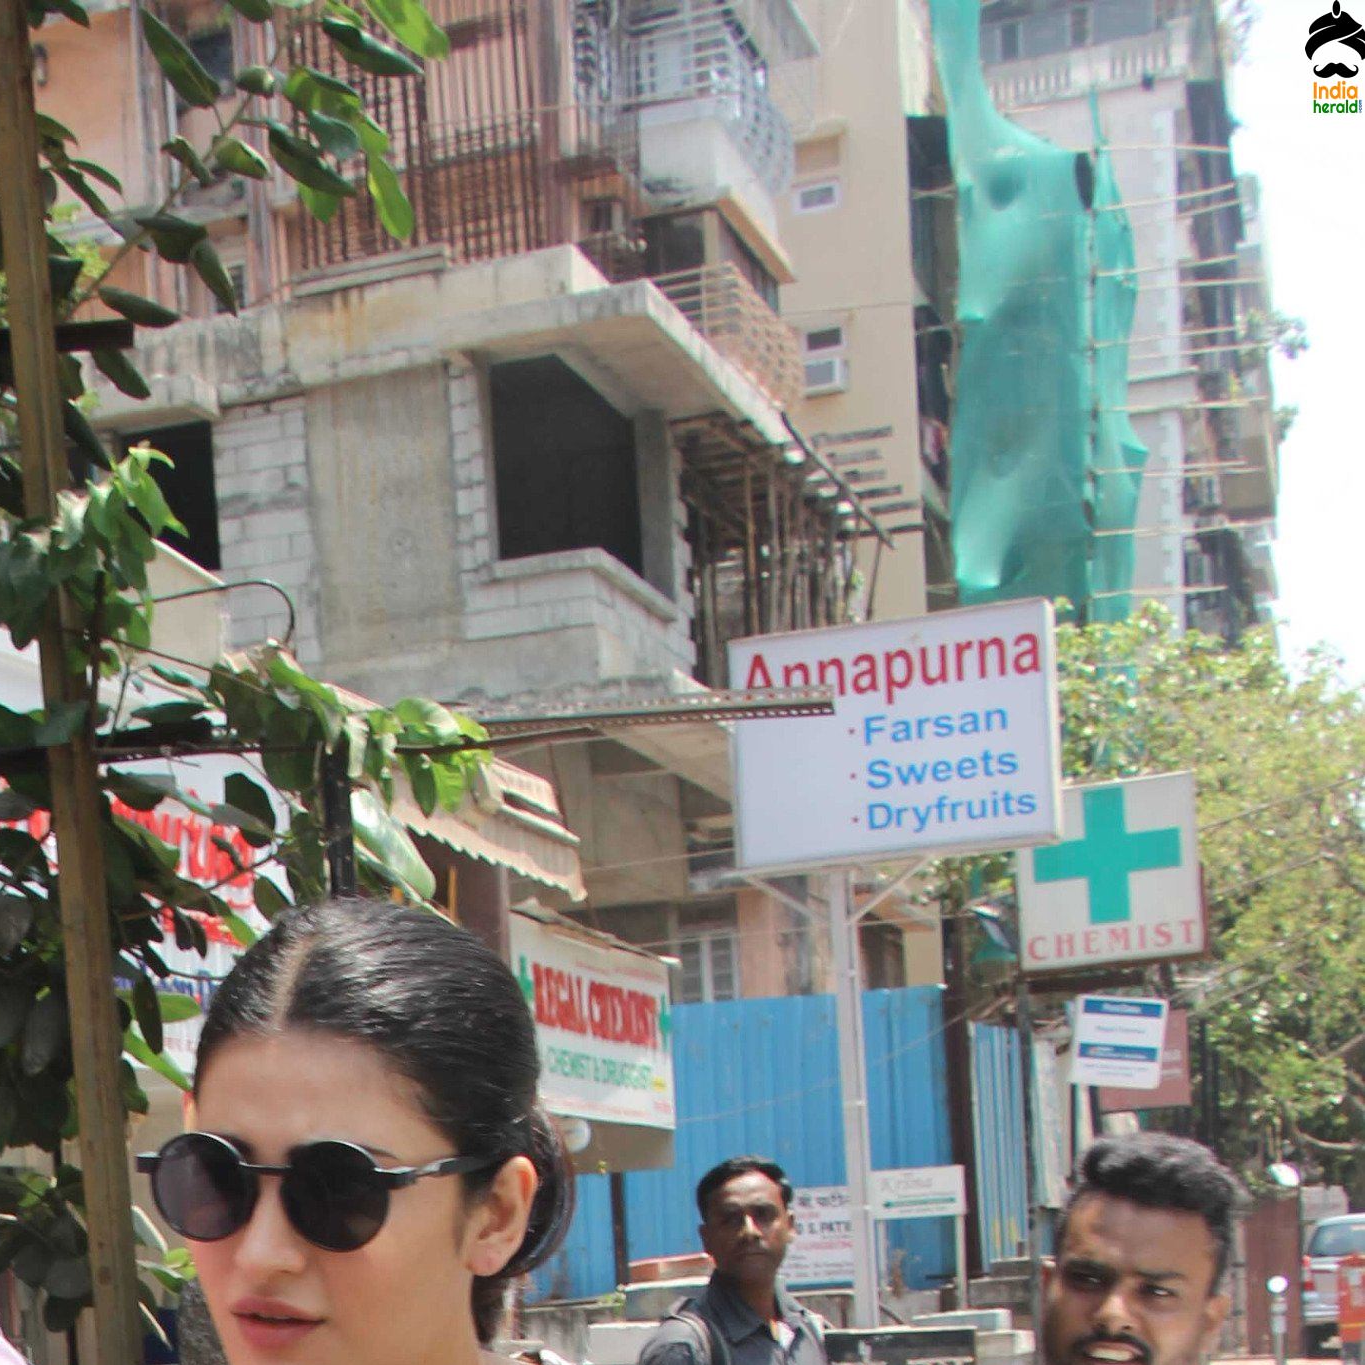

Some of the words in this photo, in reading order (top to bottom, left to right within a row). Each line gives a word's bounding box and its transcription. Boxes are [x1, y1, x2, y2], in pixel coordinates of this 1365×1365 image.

[746, 632, 1041, 704] Annapurna
[863, 708, 1009, 746] Farsan
[866, 750, 1019, 789] Sweets
[867, 792, 1037, 832] Dryfruits
[1027, 919, 1195, 961] CHEMIST
